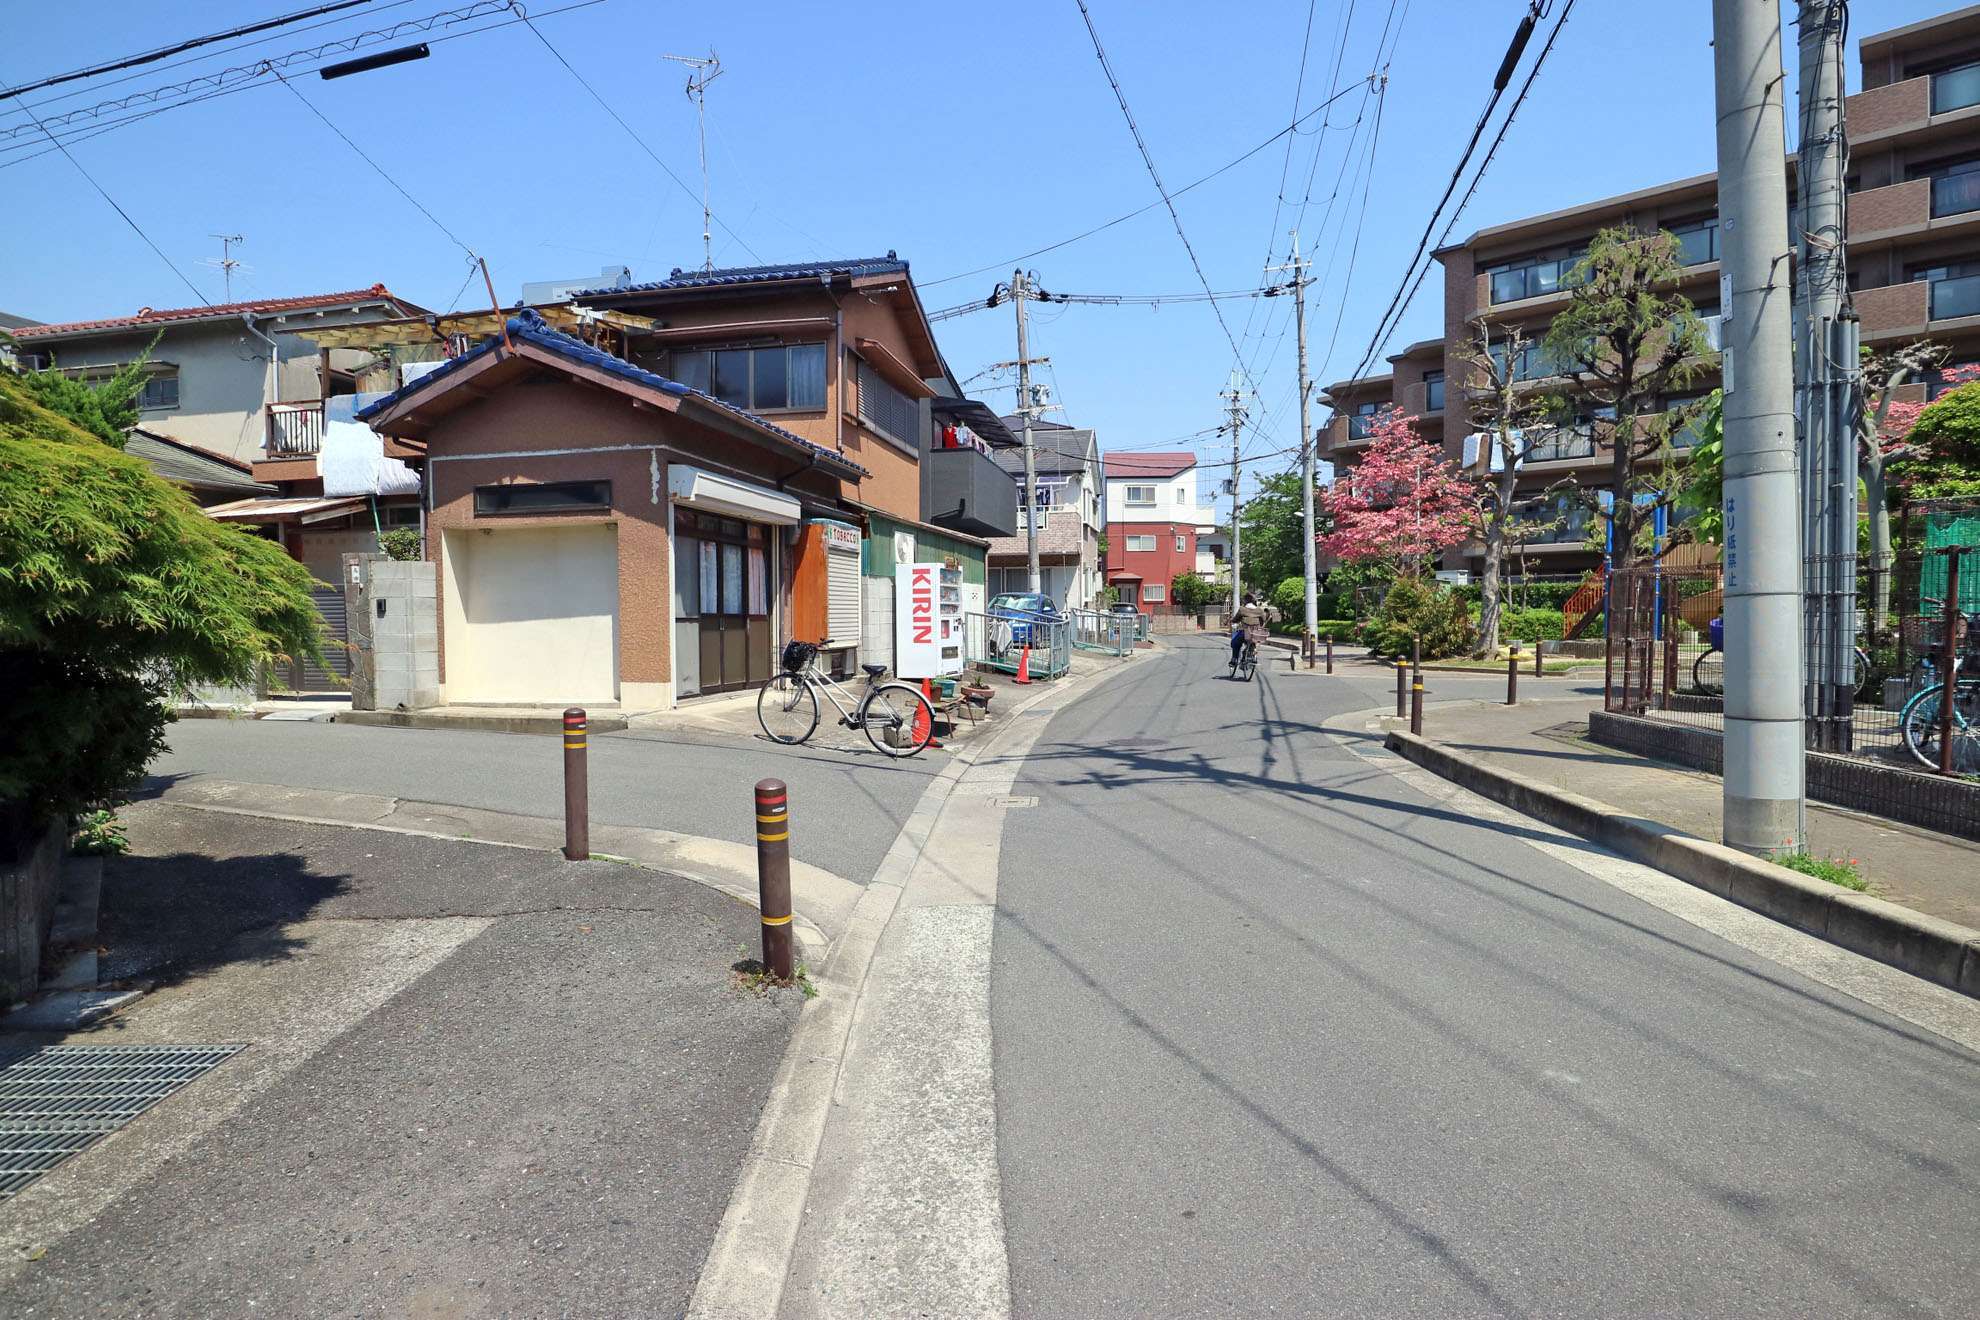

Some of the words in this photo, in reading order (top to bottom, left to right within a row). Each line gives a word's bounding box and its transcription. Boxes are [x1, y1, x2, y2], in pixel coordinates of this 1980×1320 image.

[833, 528, 857, 544] TOBACCO
[1726, 497, 1737, 587] はり紙禁止
[912, 568, 932, 644] KIRIN
